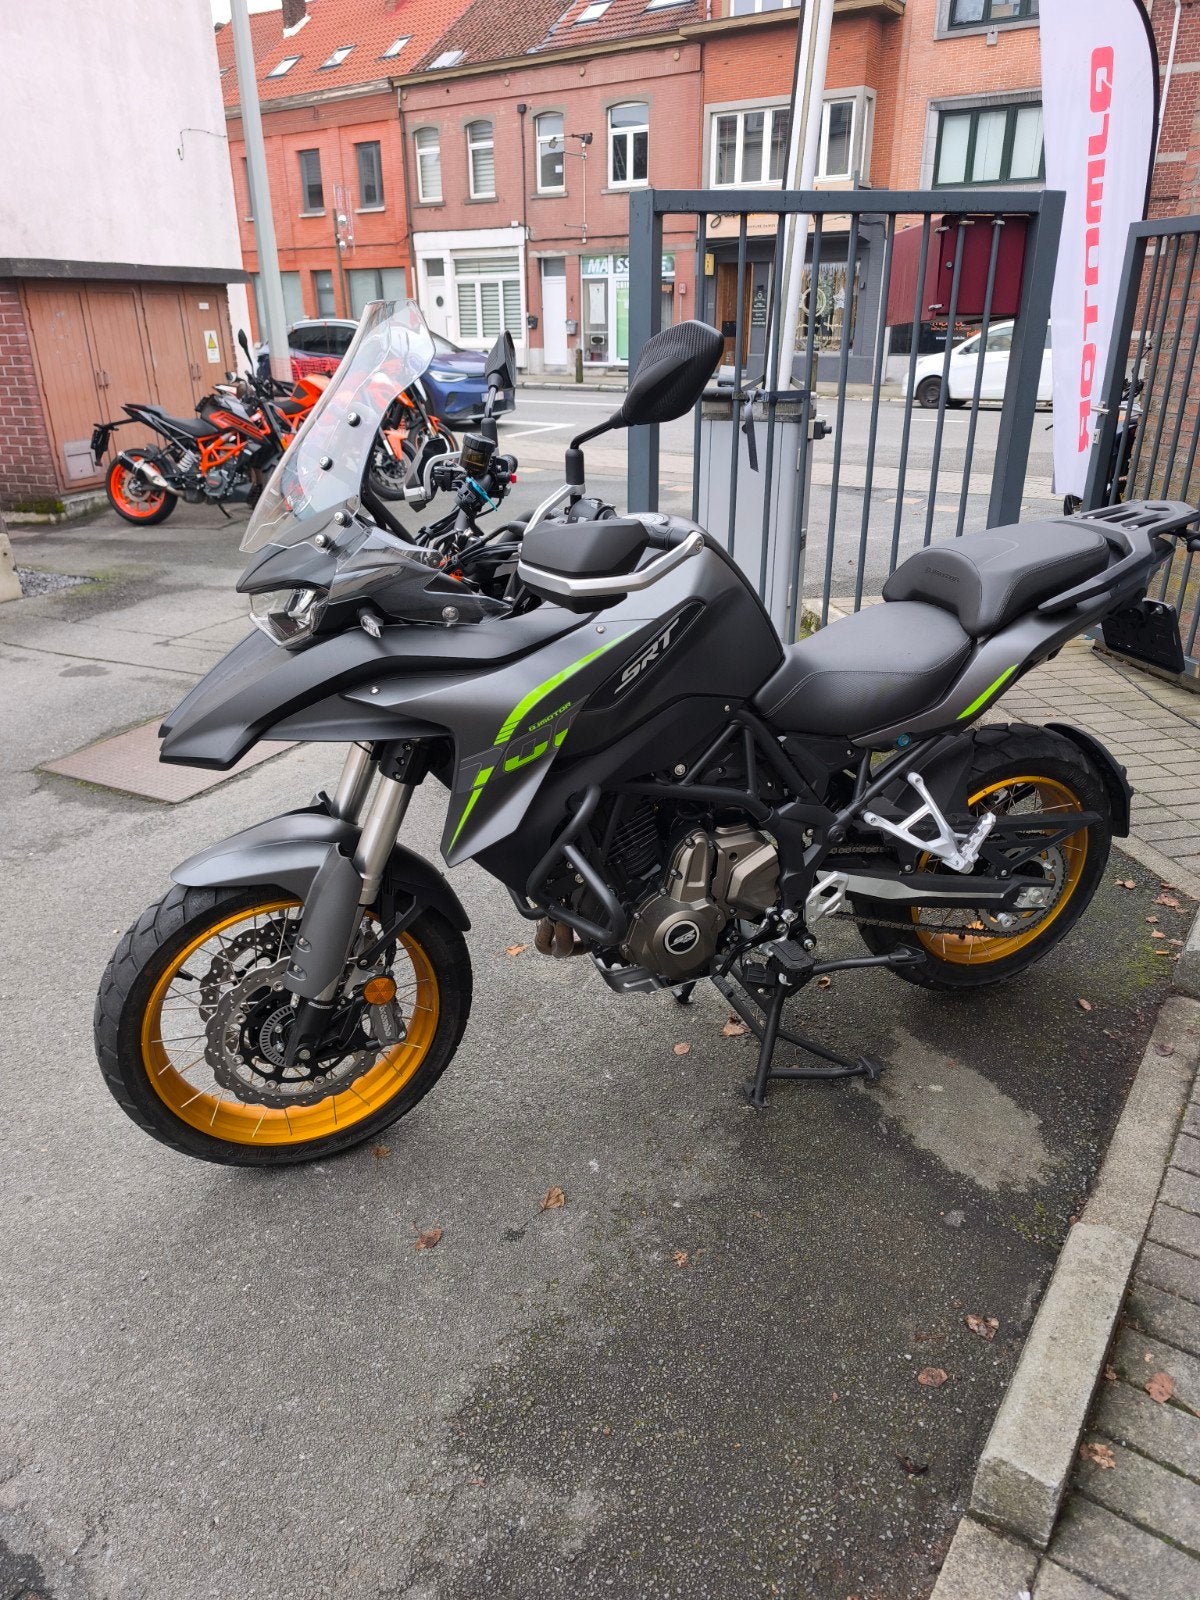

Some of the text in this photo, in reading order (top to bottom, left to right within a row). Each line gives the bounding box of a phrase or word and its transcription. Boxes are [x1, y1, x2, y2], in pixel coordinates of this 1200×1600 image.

[587, 255, 668, 273] MASSE
[614, 618, 679, 694] SRT
[528, 702, 573, 732] QJMOTOR
